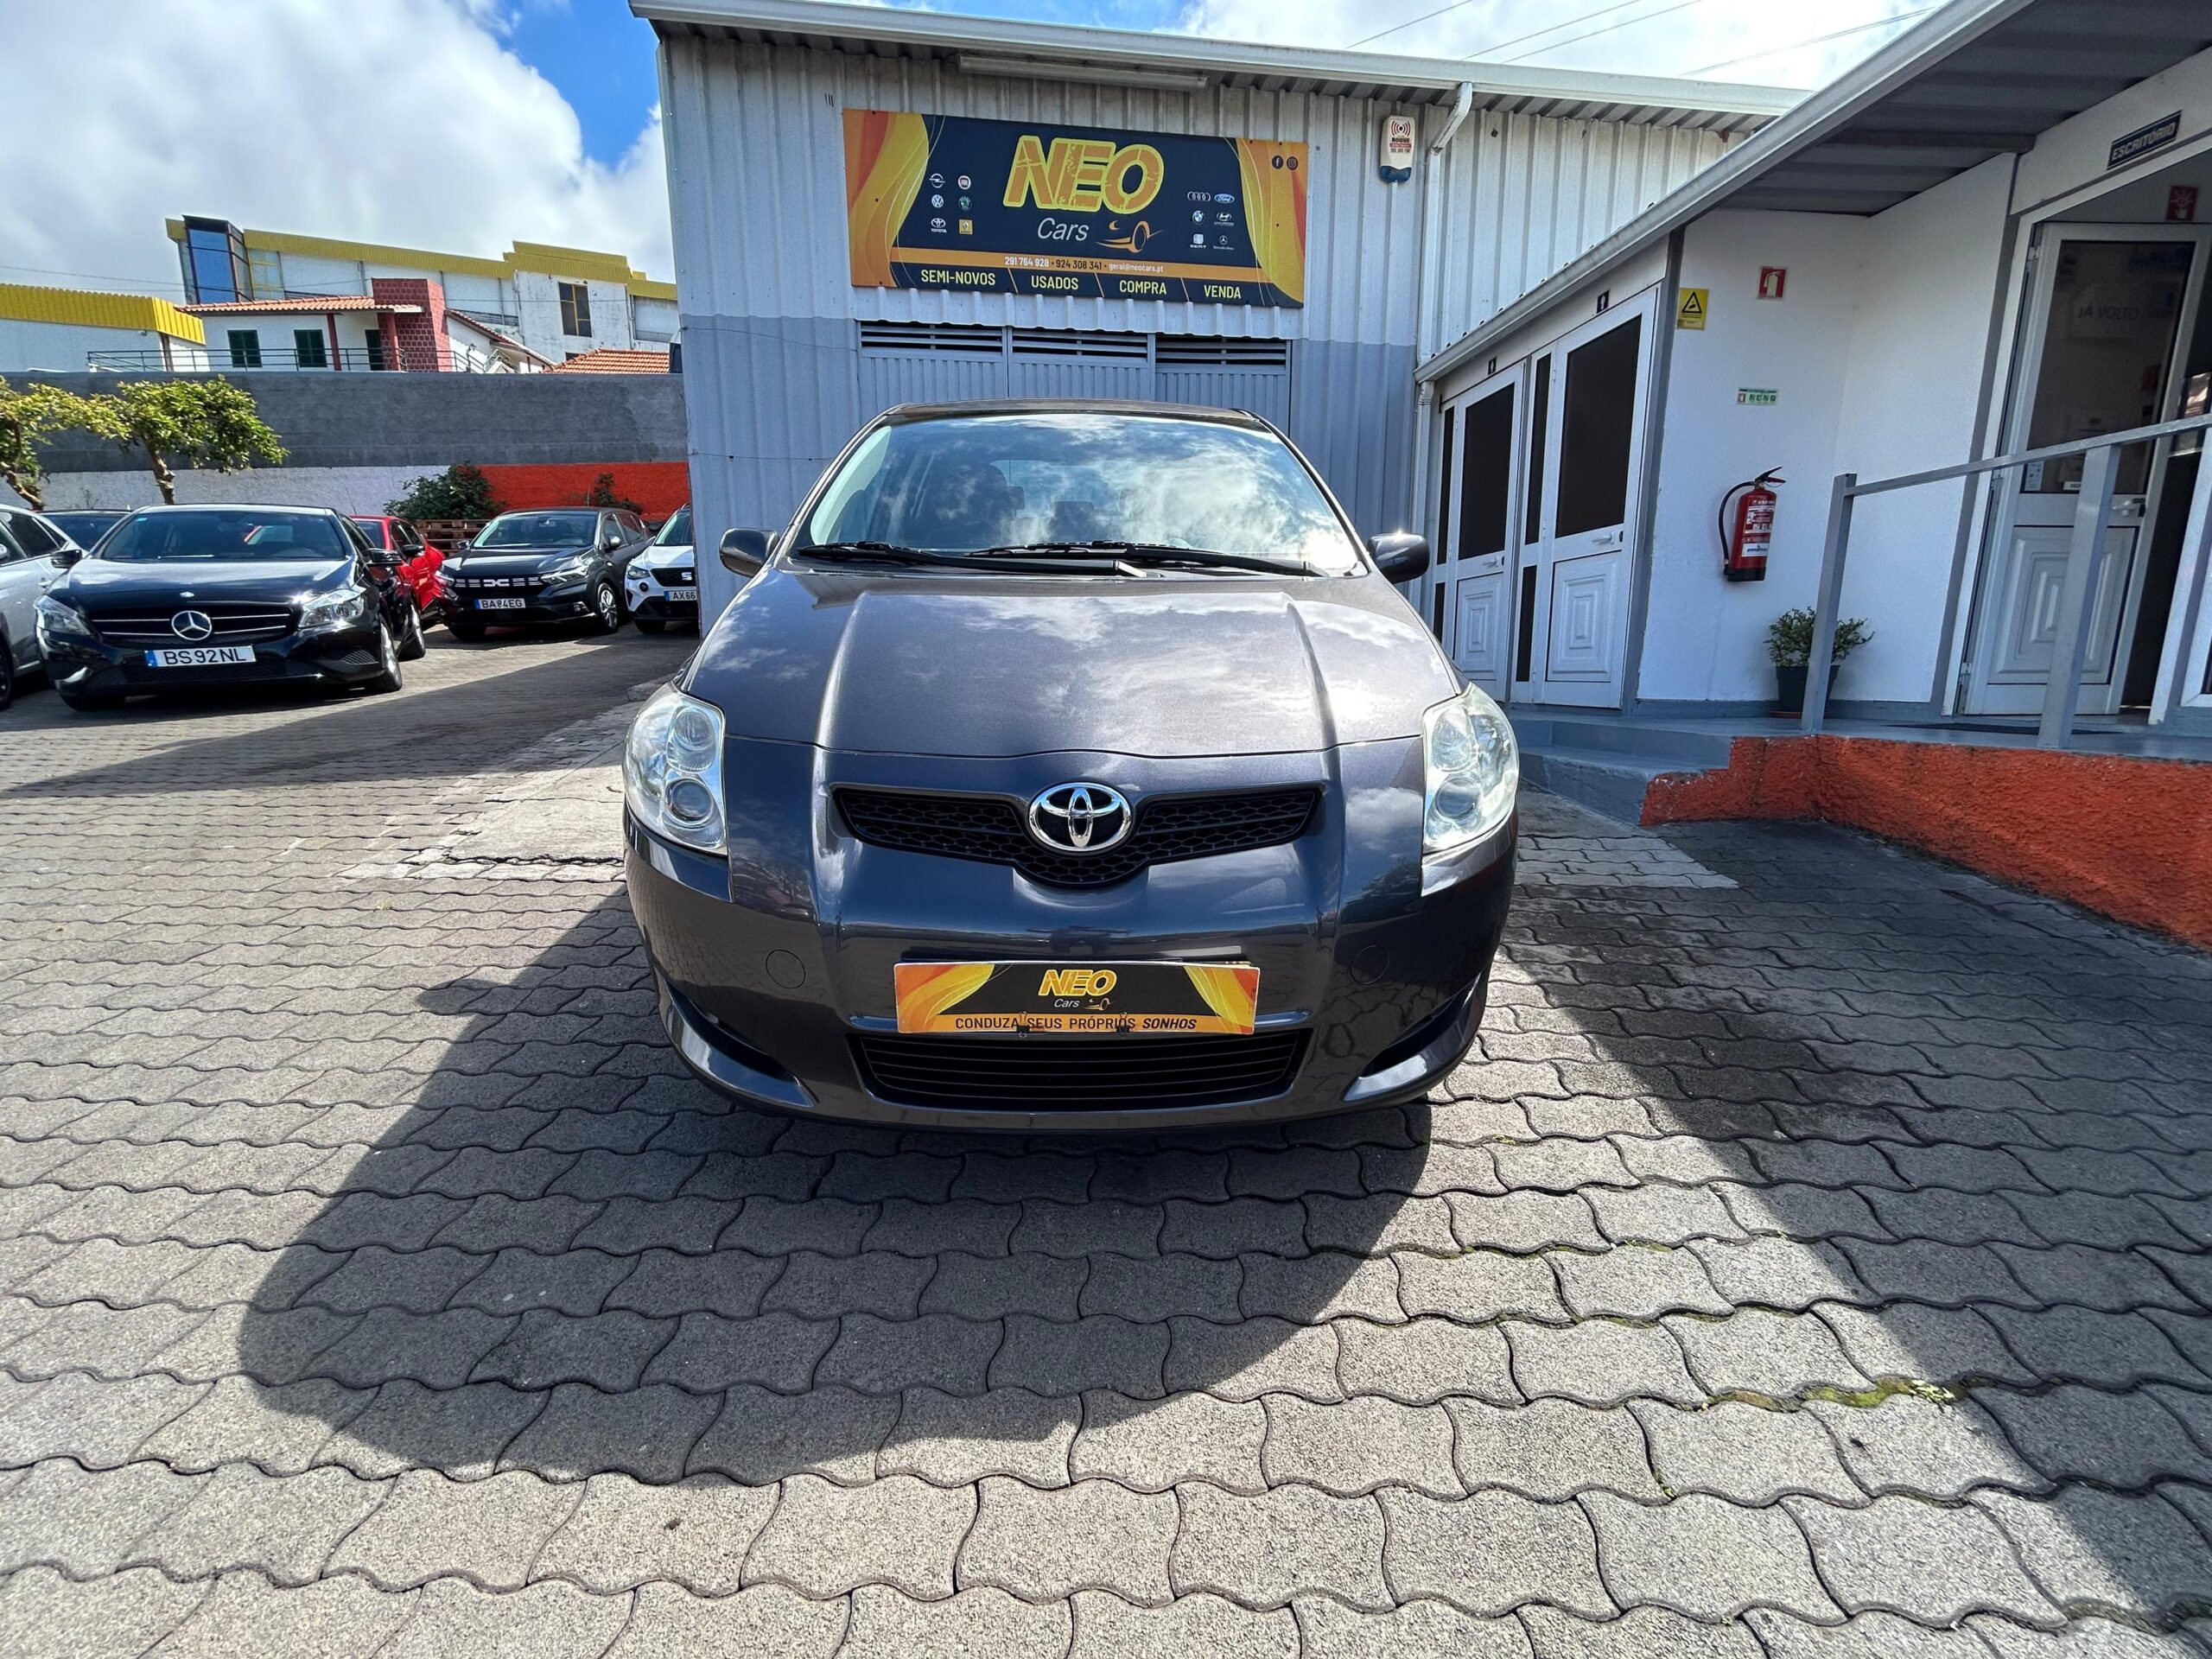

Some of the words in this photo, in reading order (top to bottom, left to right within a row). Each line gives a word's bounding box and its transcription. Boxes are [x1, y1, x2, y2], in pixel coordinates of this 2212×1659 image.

[1002, 135, 1165, 214] NEO
[1037, 218, 1090, 241] Cars
[1004, 256, 1018, 266] 291
[1019, 257, 1033, 267] 764
[1034, 257, 1049, 268] 928
[1056, 258, 1071, 269] 924
[1072, 260, 1087, 270] 308
[1089, 261, 1103, 270] 341
[1109, 262, 1164, 274] geral@neocars.pt
[921, 269, 995, 286] SEMI-NOVOS
[1031, 275, 1079, 290] USADOS
[1119, 280, 1167, 296] COMPRA
[1204, 284, 1242, 300] VENDA
[1038, 969, 1117, 997] NEO
[1054, 998, 1080, 1008] Cars
[955, 1017, 1019, 1029] CONDUZA
[1027, 1018, 1062, 1029] SEUS
[1142, 1018, 1198, 1029] SONHOS
